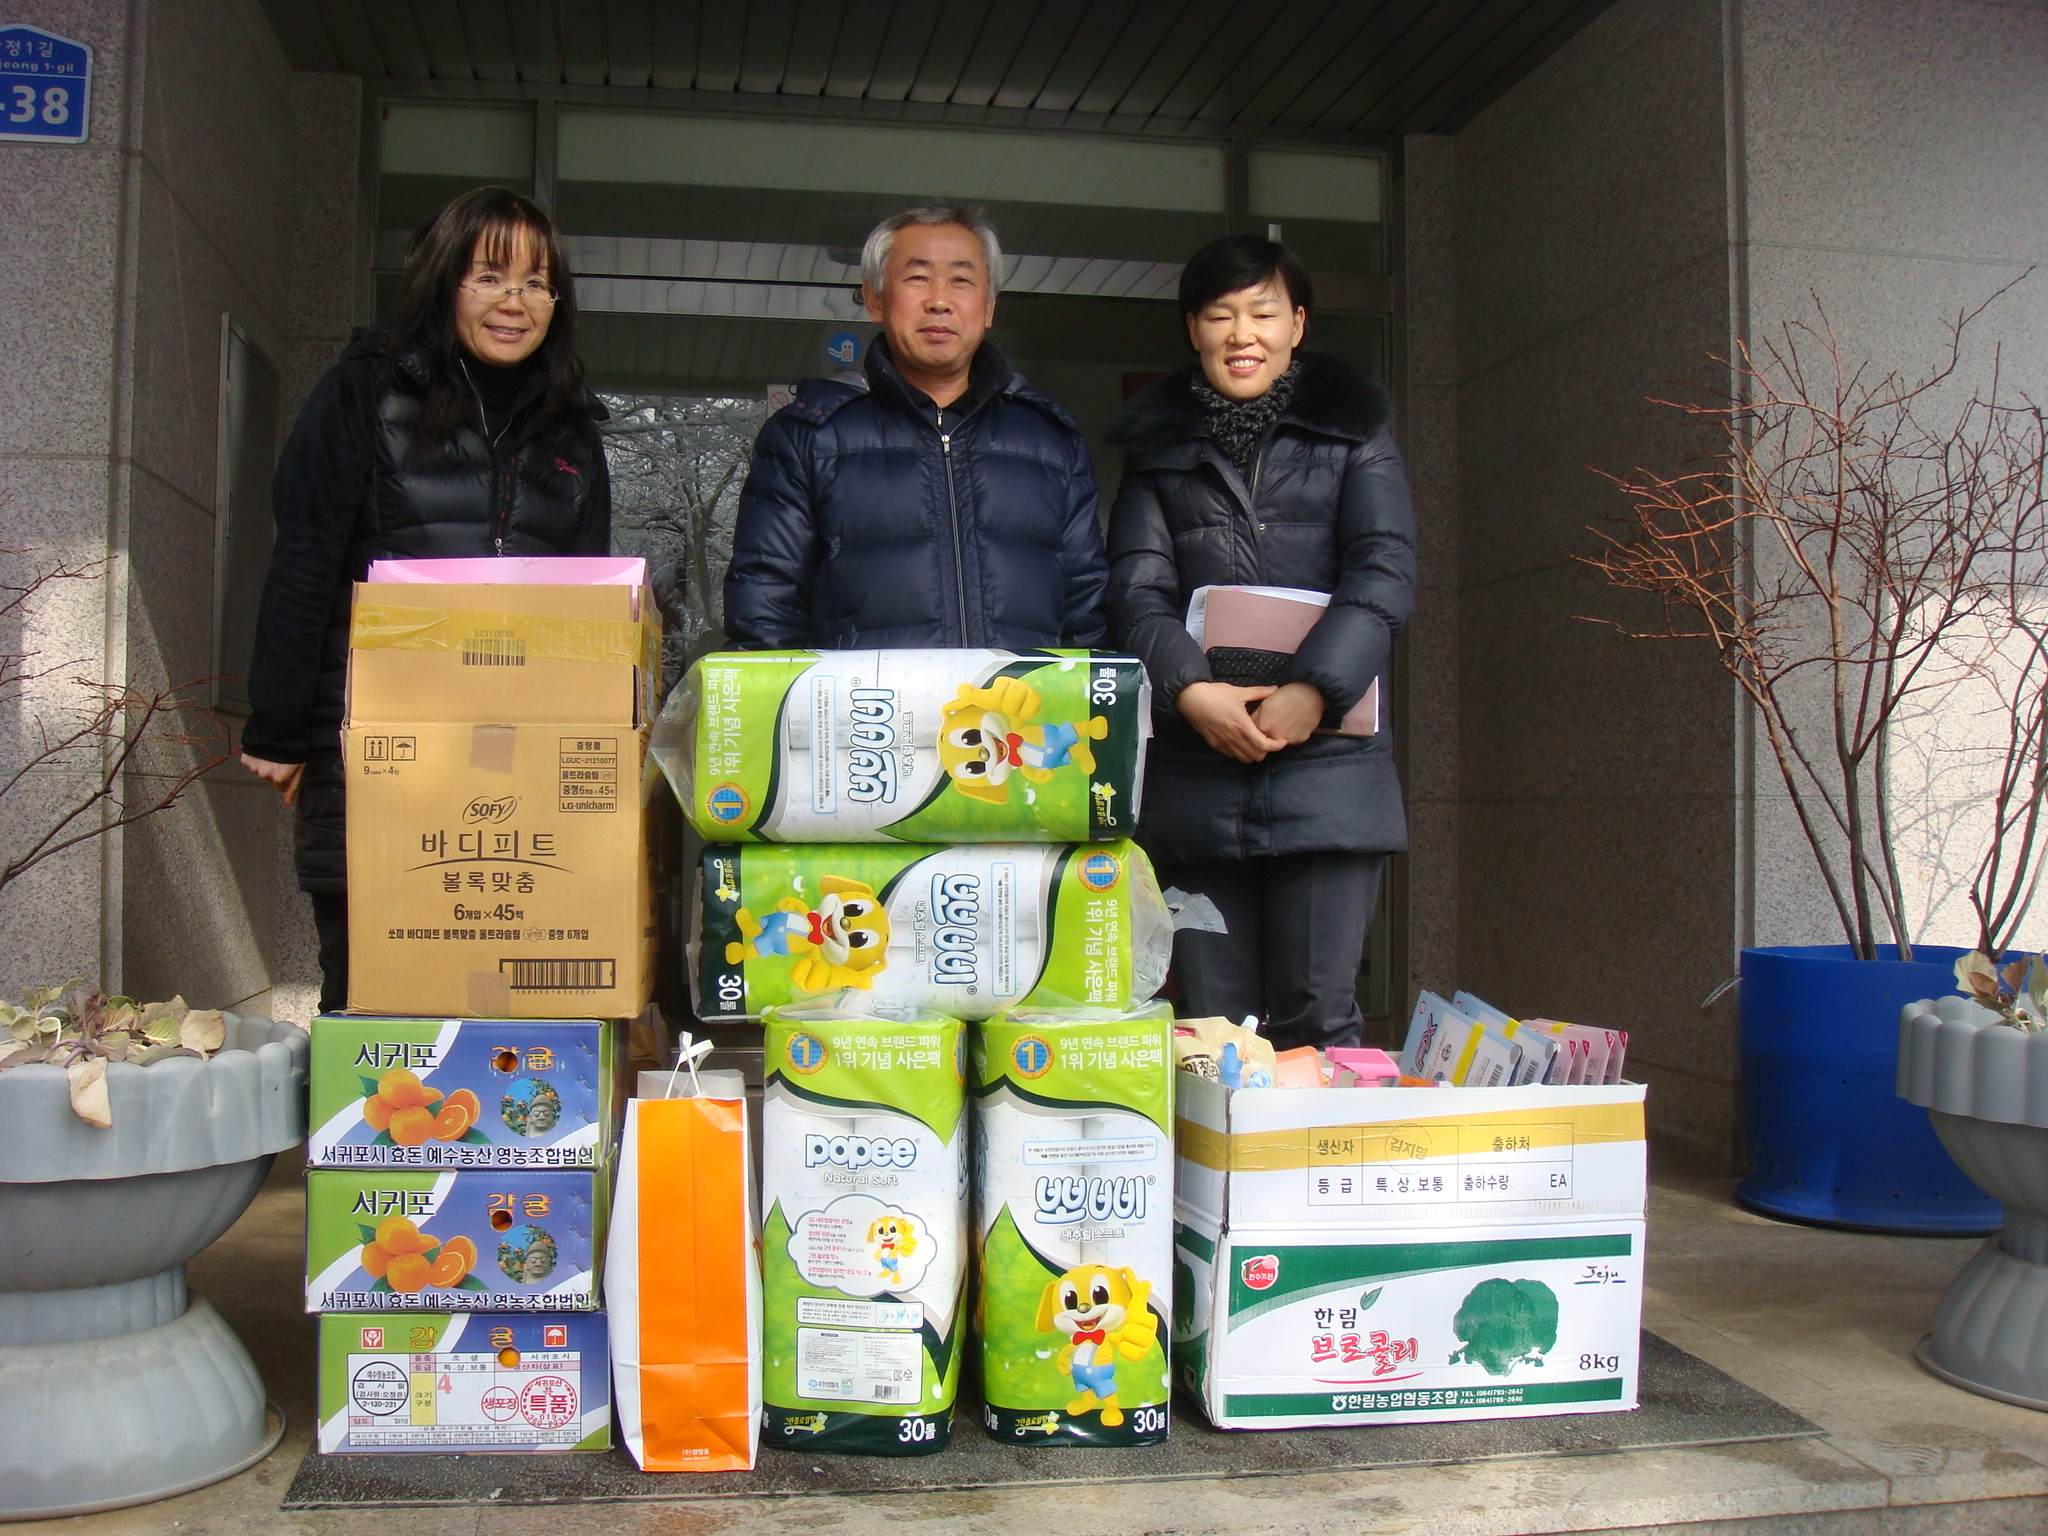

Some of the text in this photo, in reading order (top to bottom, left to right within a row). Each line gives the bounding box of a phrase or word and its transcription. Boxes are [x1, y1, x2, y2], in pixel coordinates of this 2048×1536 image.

[0, 39, 53, 58] 정1길
[1093, 667, 1117, 706] 30롤
[708, 668, 721, 776] 9년 연속 브랜드 파워
[723, 668, 742, 775] 1위 기념 사은팩
[577, 741, 600, 751] 증정품
[902, 711, 916, 776] 내추럴 소프트
[562, 771, 599, 780] 울트라슬림
[469, 799, 513, 818] SOFY
[420, 829, 557, 859] 바디피트
[442, 871, 535, 894] 볼록맞춤
[388, 929, 404, 940] 쏘피
[407, 929, 440, 940] 바디피트
[443, 929, 476, 940] 볼록맞춤
[479, 929, 520, 940] 울트라슬림
[548, 929, 564, 940] 중형
[567, 929, 589, 940] 6개입
[913, 901, 926, 964] 내추럴 소프트
[1085, 899, 1103, 1003] 1위 기념 사은팩
[1105, 899, 1118, 1002] 9년 연속 브랜드 파워
[718, 974, 743, 1011] 30롤
[833, 1036, 852, 1049] 9년
[855, 1036, 878, 1049] 연속
[881, 1036, 917, 1049] 브랜드
[919, 1035, 941, 1049] 파워
[1060, 1034, 1162, 1050] 9년 연속 브랜드 파워
[354, 1042, 439, 1069] 서귀포
[835, 1051, 941, 1070] 1위 기념 사은팩
[1060, 1049, 1163, 1070] 1위 기념 사은팩
[805, 1133, 917, 1170] popee
[1317, 1139, 1354, 1156] 생산자
[1390, 1137, 1429, 1161] 김지명
[1492, 1136, 1531, 1153] 출하처
[321, 1146, 594, 1165] 서귀포시 효돈 예수농산 영농조합법인
[824, 1172, 899, 1187] Natural Soft
[1463, 1174, 1509, 1191] 출하수량
[1550, 1173, 1567, 1189] EA
[352, 1190, 553, 1218] 서귀포 감귤
[1062, 1227, 1125, 1241] 내추럴 소프트
[320, 1291, 591, 1311] 서귀포시 효돈 예수농산 영농조합법인
[1313, 1306, 1357, 1330] 한림
[1311, 1329, 1419, 1377] 브로콜리
[1578, 1353, 1620, 1373] 8kg
[414, 1364, 431, 1372] 등급
[437, 1373, 453, 1395] 4
[483, 1397, 518, 1410] 생포장
[529, 1395, 568, 1414] 특품
[1348, 1391, 1459, 1410] 한림농업협동조합
[899, 1418, 937, 1442] 30롤
[1133, 1407, 1166, 1433] 30롤
